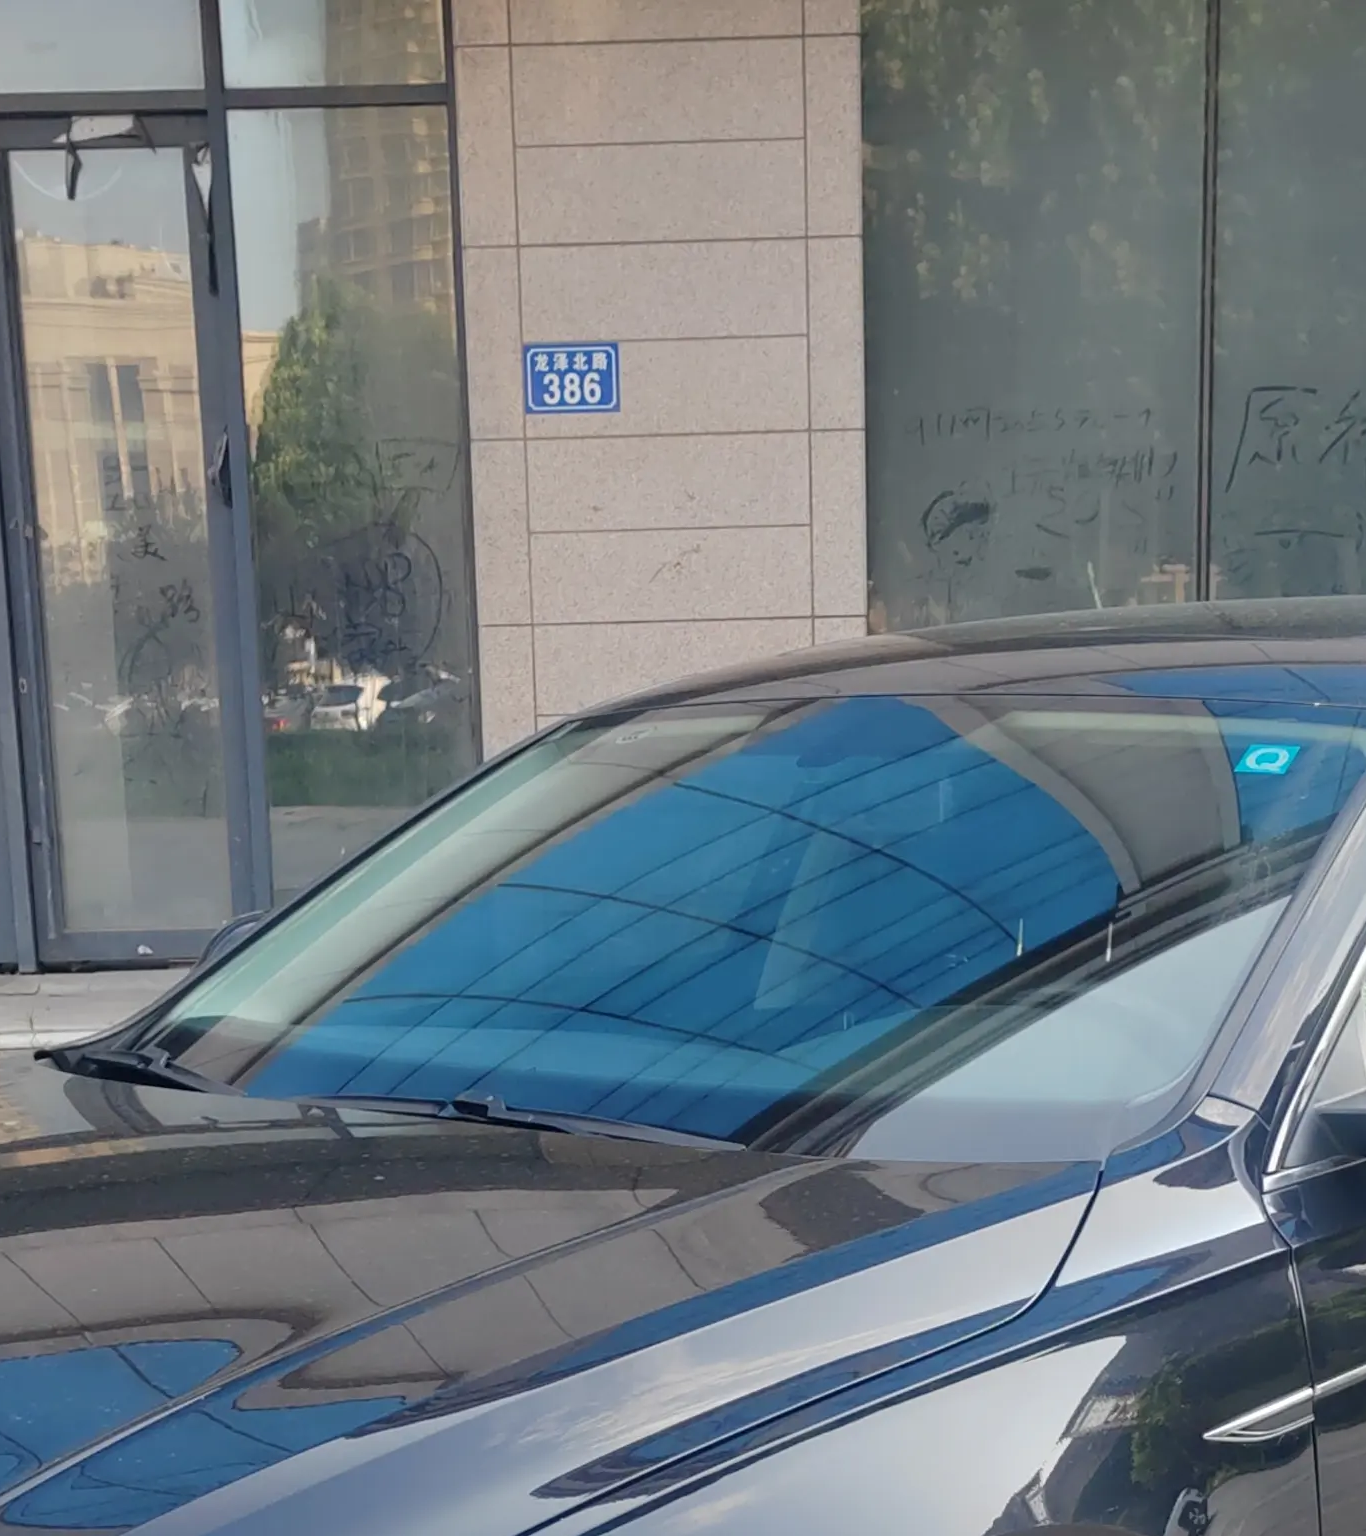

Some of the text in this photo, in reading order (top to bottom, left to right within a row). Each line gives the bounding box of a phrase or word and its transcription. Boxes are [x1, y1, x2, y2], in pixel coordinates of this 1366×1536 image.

[534, 352, 608, 372] 龙泽北路
[542, 371, 602, 405] 386
